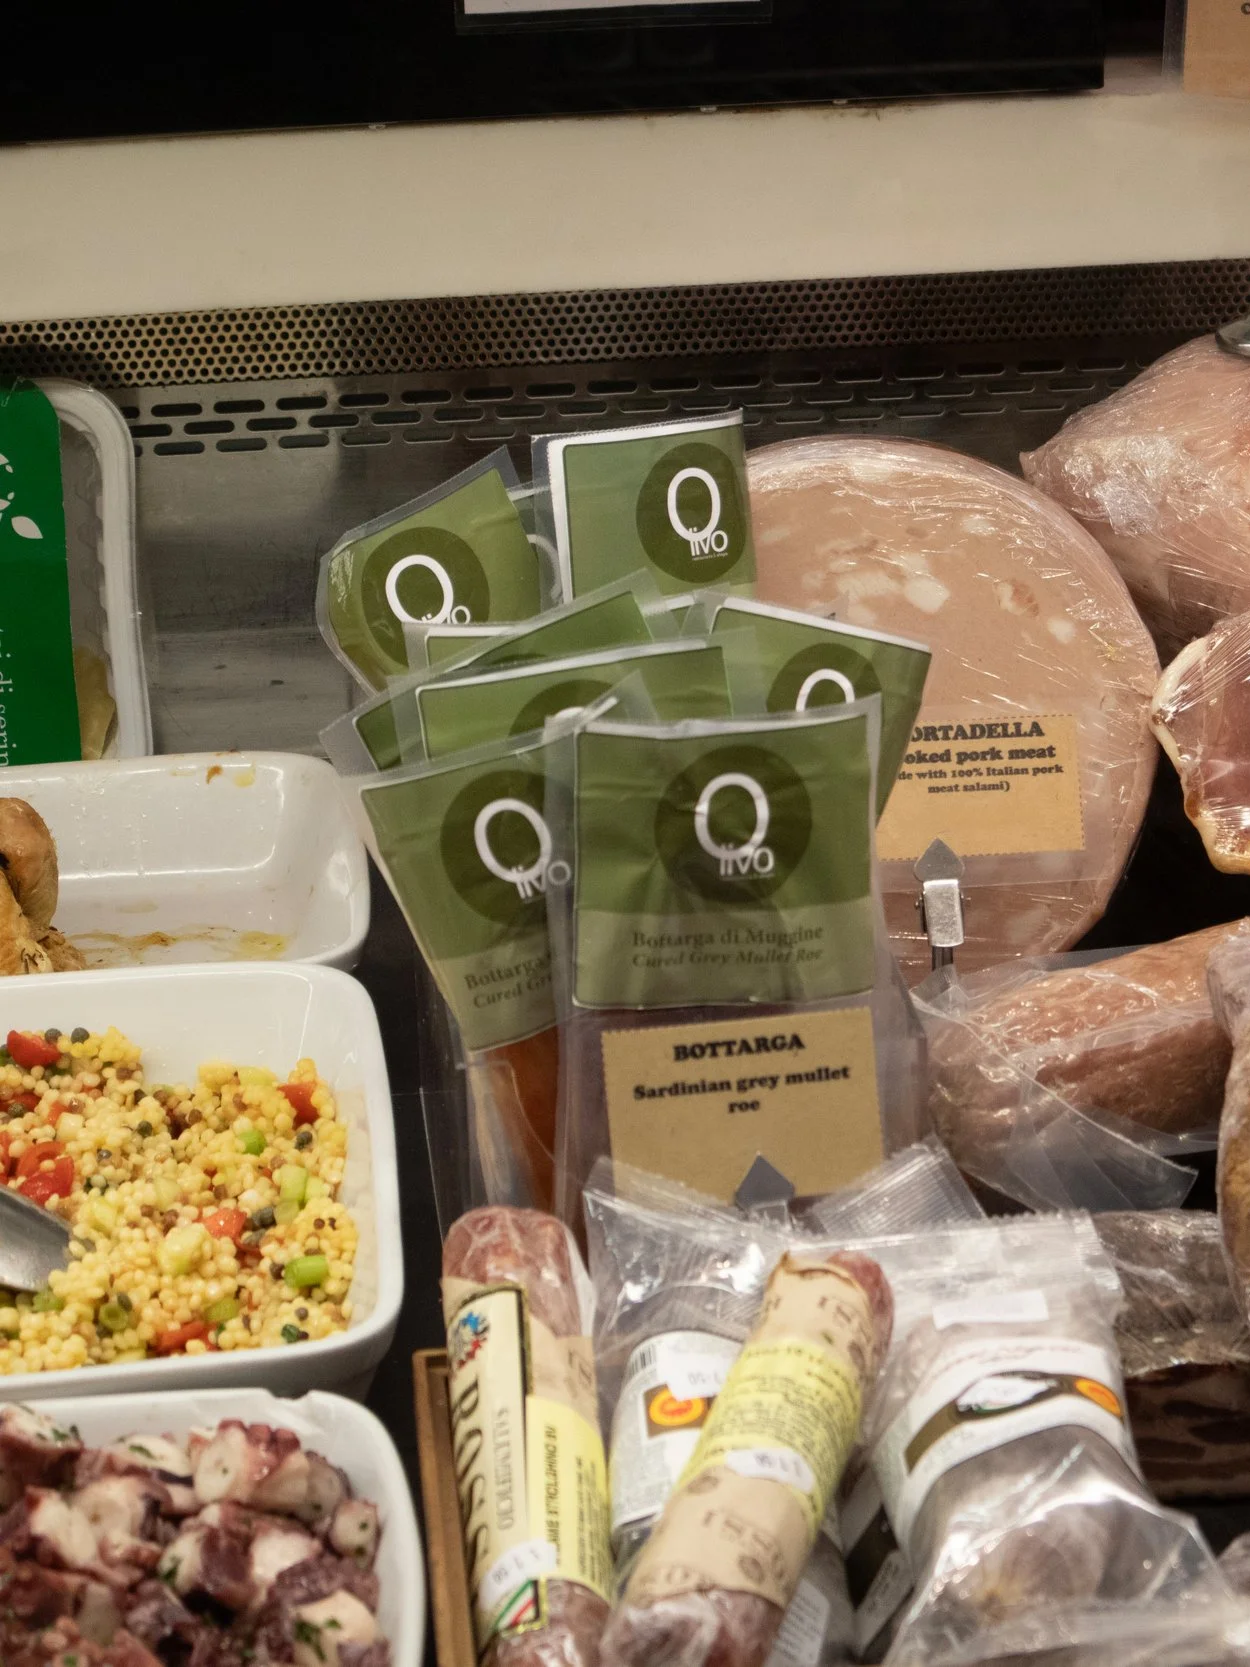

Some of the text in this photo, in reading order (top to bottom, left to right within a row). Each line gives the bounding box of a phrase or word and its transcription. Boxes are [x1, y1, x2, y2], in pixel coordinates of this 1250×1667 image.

[911, 721, 1045, 742] ORTADELLA
[903, 744, 1056, 765] oked pork meat
[916, 767, 947, 780] with
[951, 767, 983, 779] 100%
[986, 765, 1029, 777] Italian
[1032, 763, 1064, 776] pork
[928, 780, 1010, 794] meat salami)
[673, 1033, 805, 1061] BOTTARGA
[634, 1066, 851, 1100] Sardinian grey mullet
[728, 1100, 761, 1113] roe
